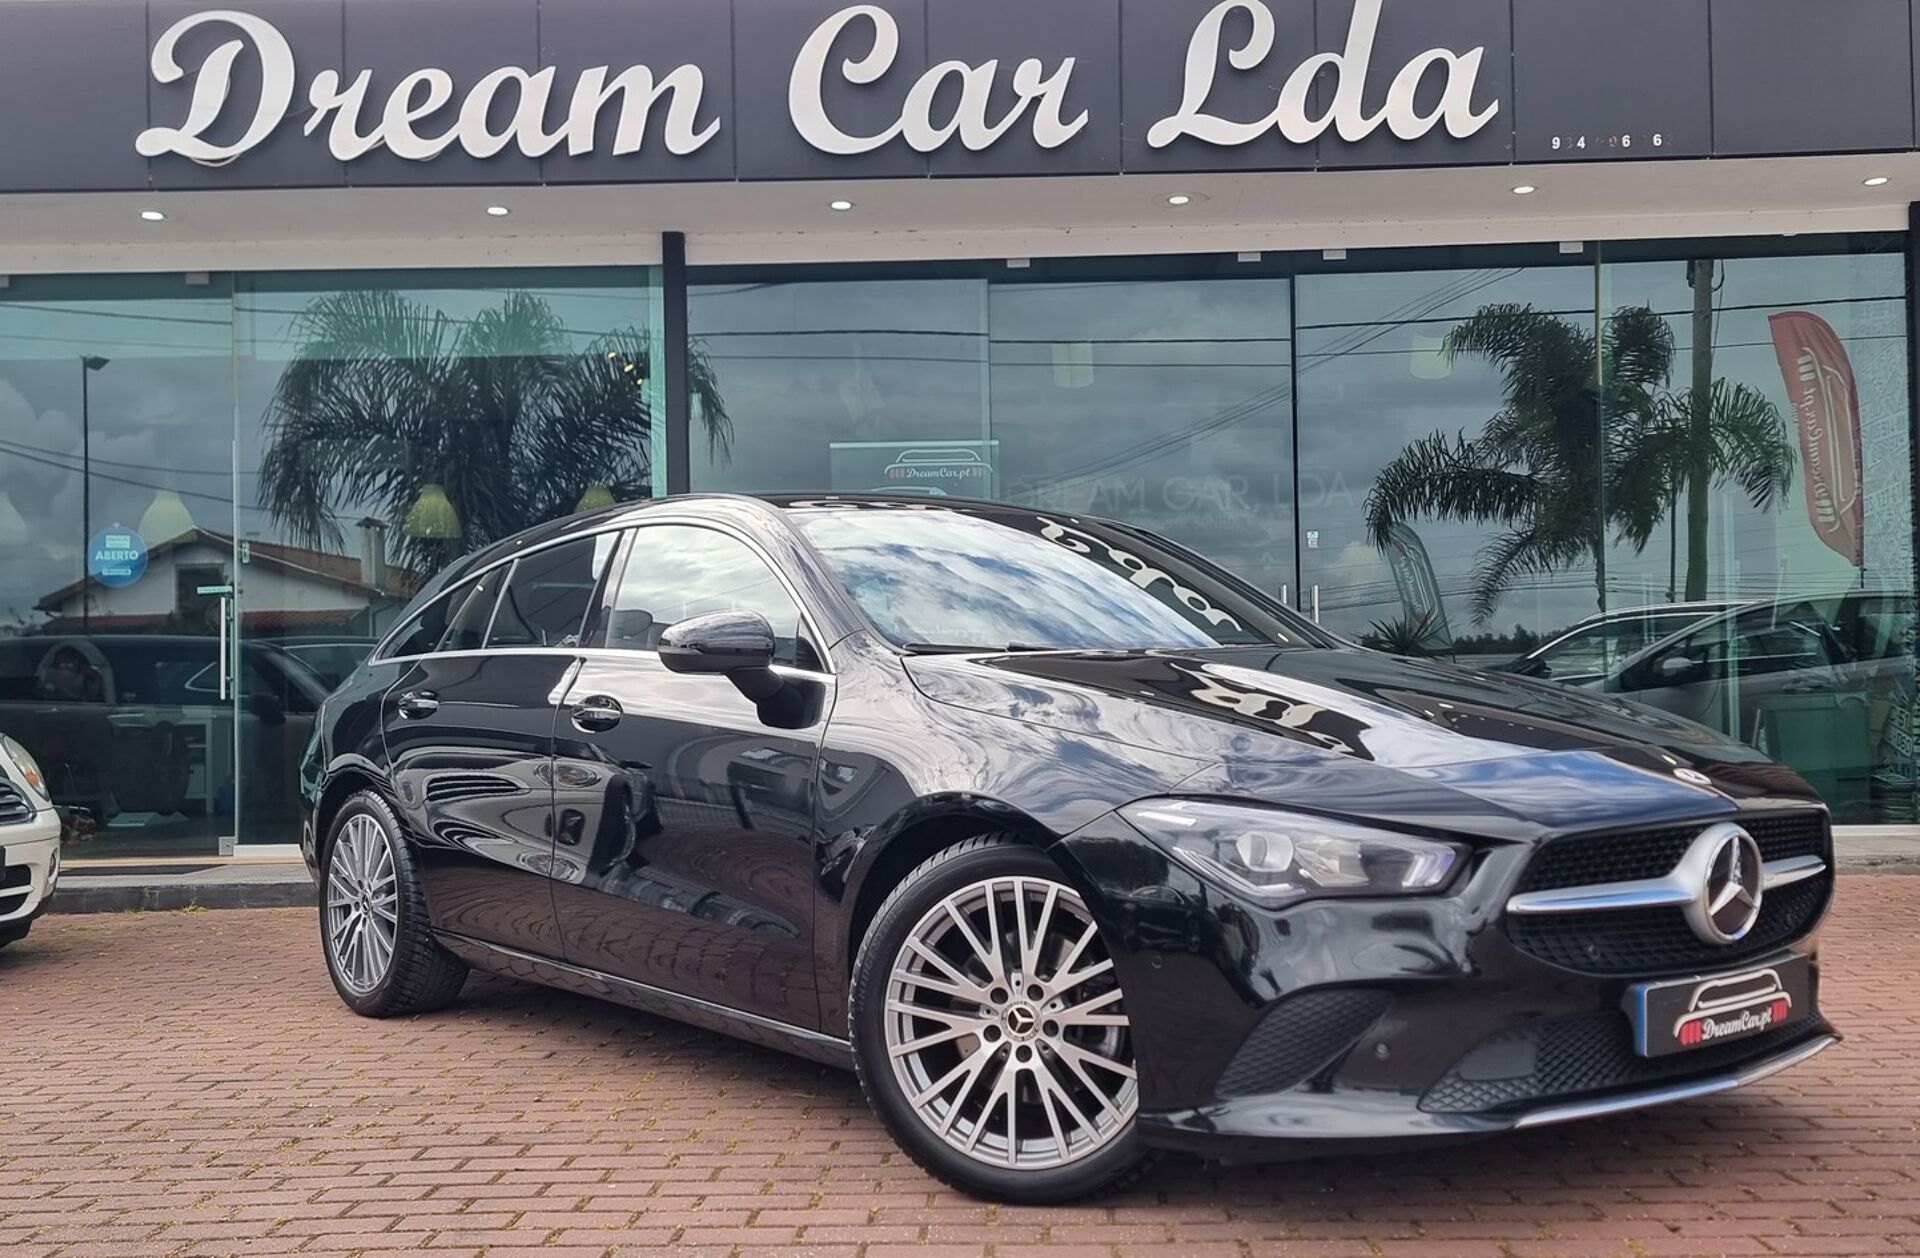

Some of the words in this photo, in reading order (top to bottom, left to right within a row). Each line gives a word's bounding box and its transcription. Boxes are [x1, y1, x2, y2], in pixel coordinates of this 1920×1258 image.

[135, 10, 721, 163] Dream
[788, 4, 1089, 154] Car
[1147, 0, 1499, 147] Lda
[906, 467, 970, 480] DreamCar.pt
[95, 550, 139, 561] ABERTO
[1702, 1006, 1773, 1041] DreamCar.pt
